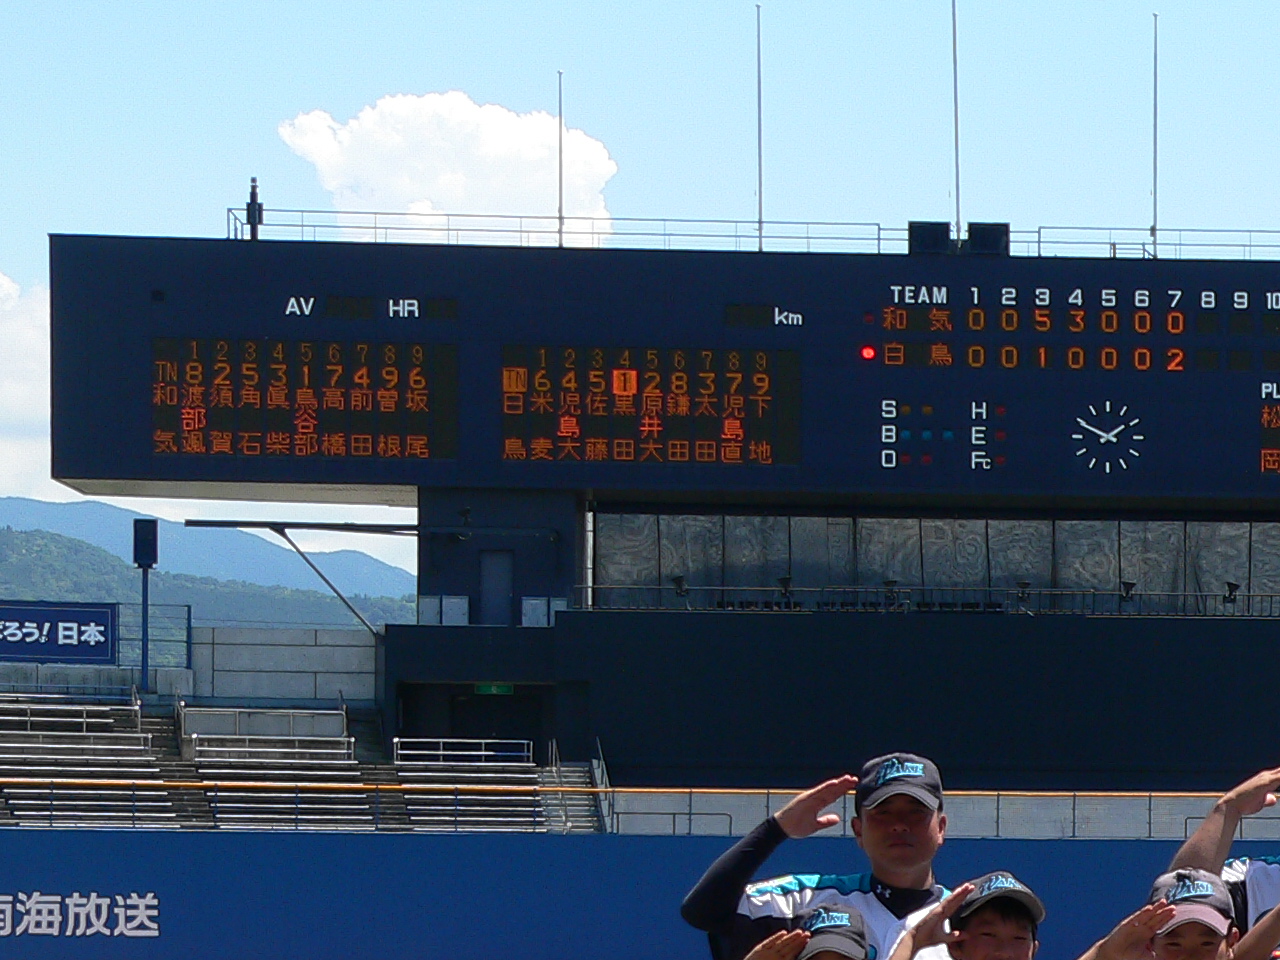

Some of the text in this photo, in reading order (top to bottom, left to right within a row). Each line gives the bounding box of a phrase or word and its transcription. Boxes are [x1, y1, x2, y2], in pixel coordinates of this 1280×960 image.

[285, 298, 315, 316] AV
[389, 299, 419, 317] HR
[891, 286, 947, 304] TEAM
[971, 287, 979, 304] 1
[1002, 288, 1016, 305] 2
[1036, 289, 1049, 306] 3
[1068, 289, 1082, 306] 4
[1102, 290, 1116, 306] 5
[1135, 291, 1149, 307] 6
[1167, 291, 1182, 307] 7
[1201, 292, 1216, 308] 8
[1234, 292, 1248, 308] 9
[774, 307, 803, 325] km
[882, 307, 952, 330] 和気
[968, 309, 984, 330] 0
[1002, 309, 1017, 331] 0
[1035, 309, 1050, 331] 5
[1069, 310, 1084, 332] 3
[1101, 311, 1117, 332] 0
[1135, 312, 1150, 333] 0
[1167, 312, 1184, 334] 0
[191, 341, 423, 364] 1 2 3 4 5 6 7 8 9
[540, 349, 767, 370] 1 2 3 4 5 6 7 8 9
[885, 343, 952, 366] 白鳥
[968, 346, 984, 367] 0
[1002, 346, 1017, 367] 0
[1039, 347, 1046, 367] 1
[1068, 348, 1084, 368] 0
[1101, 348, 1117, 369] 0
[1135, 349, 1150, 370] 0
[1167, 350, 1184, 371] 2
[186, 363, 203, 384] 8
[213, 364, 231, 385] 2
[241, 364, 259, 385] 5
[269, 365, 287, 386] 3
[302, 366, 310, 386] 1
[325, 366, 343, 387] 7
[353, 367, 371, 388] 4
[381, 367, 399, 388] 9
[409, 368, 427, 389] 6
[533, 371, 551, 391] 6
[560, 371, 578, 391] 4
[588, 372, 605, 392] 5
[620, 372, 628, 392] 1
[643, 373, 660, 392] 2
[670, 373, 688, 393] 8
[697, 373, 715, 393] 3
[725, 374, 742, 394] 7
[752, 374, 770, 394] 9
[152, 383, 177, 453] 和気
[882, 401, 896, 418] S
[972, 402, 986, 419] H
[349, 389, 373, 457] 前田
[882, 425, 896, 443] B
[972, 427, 986, 444] E
[0, 621, 105, 645] ろう! 日本
